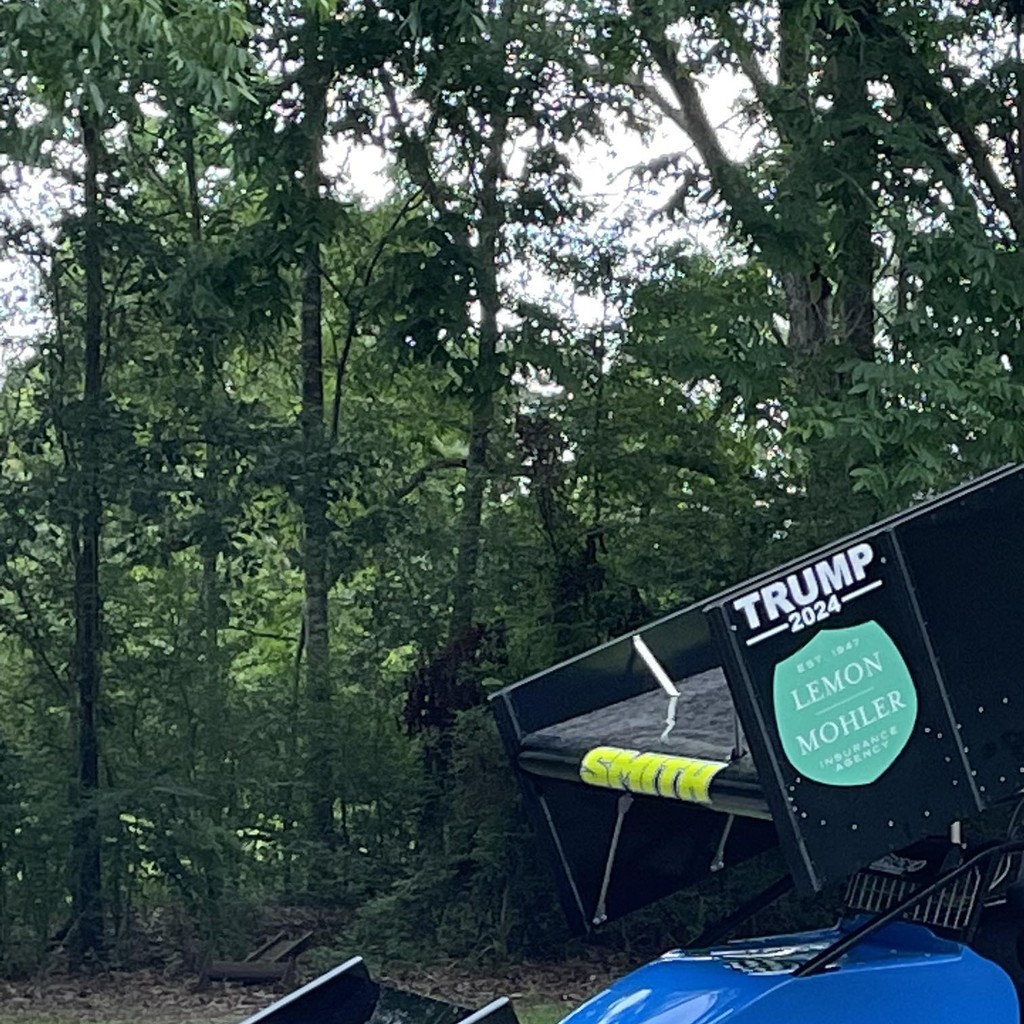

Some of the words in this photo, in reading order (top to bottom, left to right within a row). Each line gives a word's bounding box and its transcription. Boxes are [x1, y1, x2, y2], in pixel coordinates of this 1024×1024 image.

[733, 542, 874, 630] TRUMP
[788, 594, 842, 633] 2024
[796, 655, 822, 674] EST
[831, 637, 861, 656] 1947
[790, 651, 882, 711] LEMON
[795, 690, 907, 756] MOHLER
[819, 726, 897, 768] INSURANCE
[835, 741, 889, 772] AGENCY
